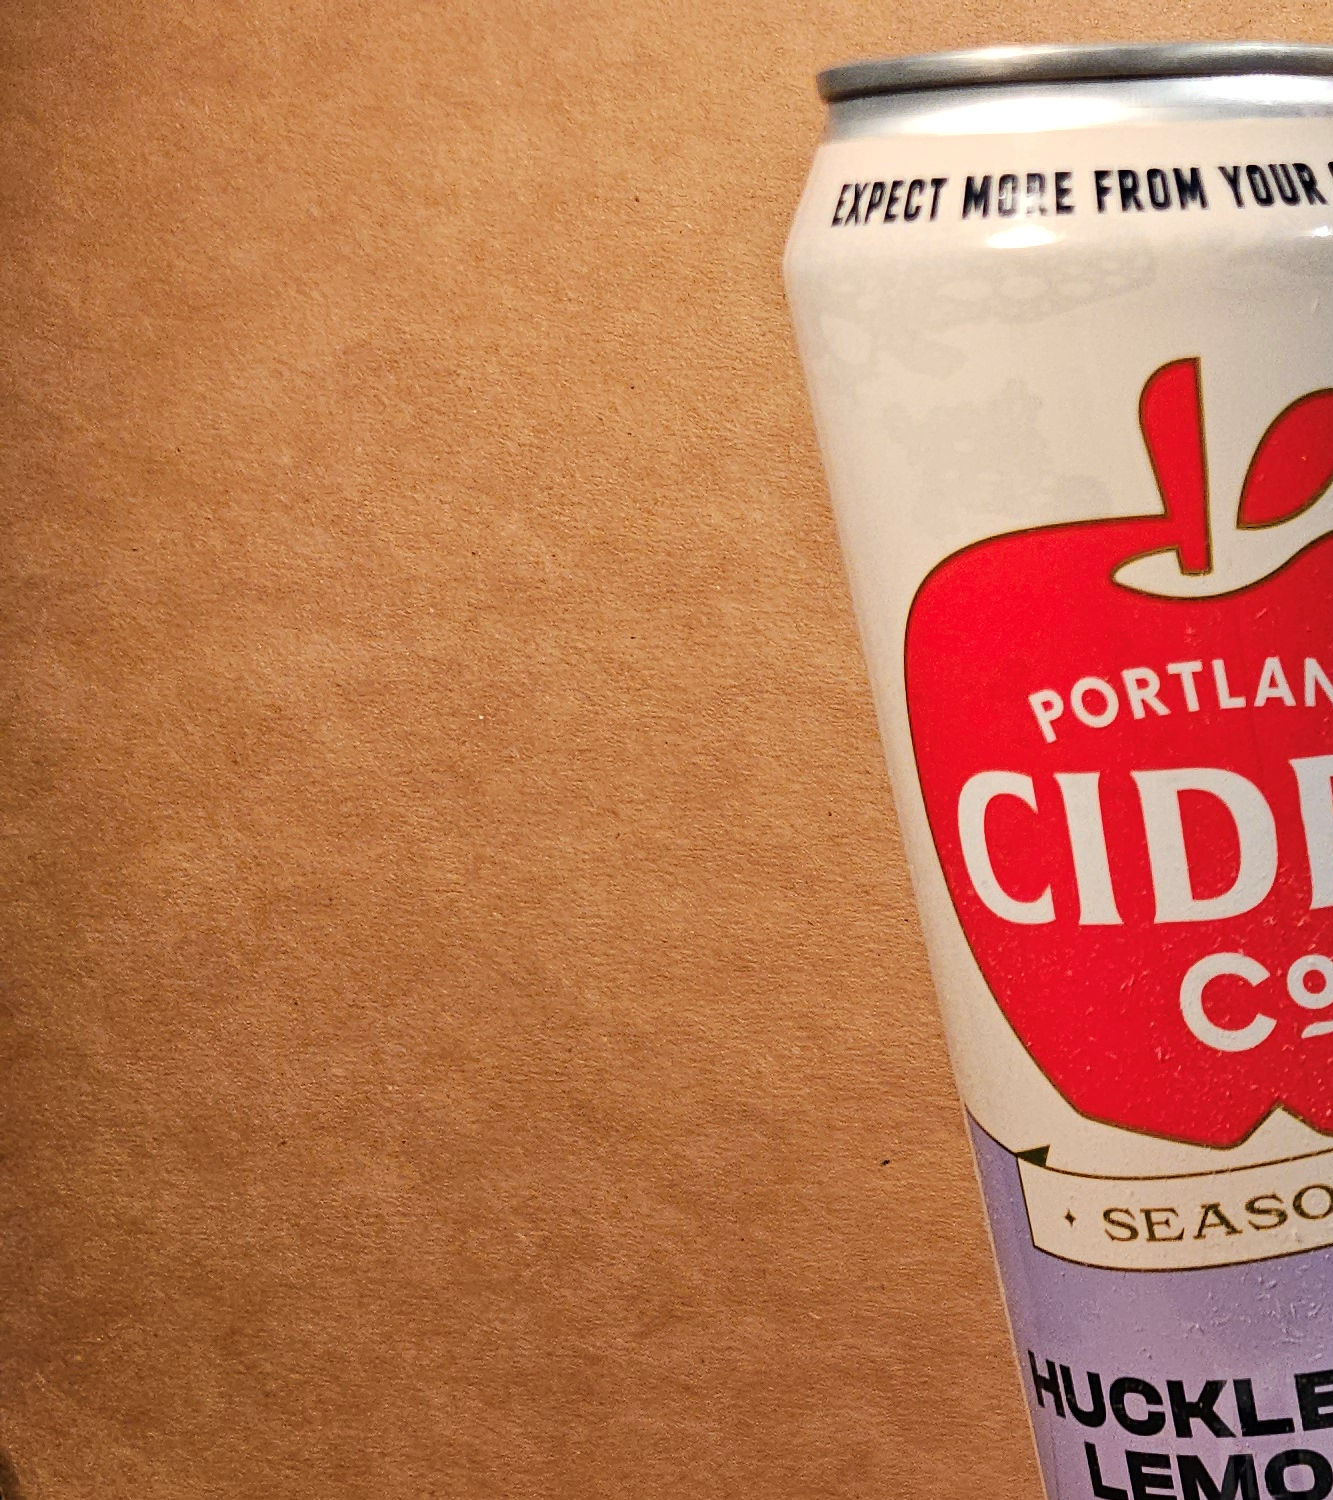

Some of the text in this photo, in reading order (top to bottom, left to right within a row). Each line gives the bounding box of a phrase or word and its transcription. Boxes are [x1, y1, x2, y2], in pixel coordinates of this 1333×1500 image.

[830, 177, 948, 228] EXPECT
[961, 170, 1074, 221] MORE
[1093, 167, 1209, 214] FROM
[1219, 161, 1323, 209] YOUR
